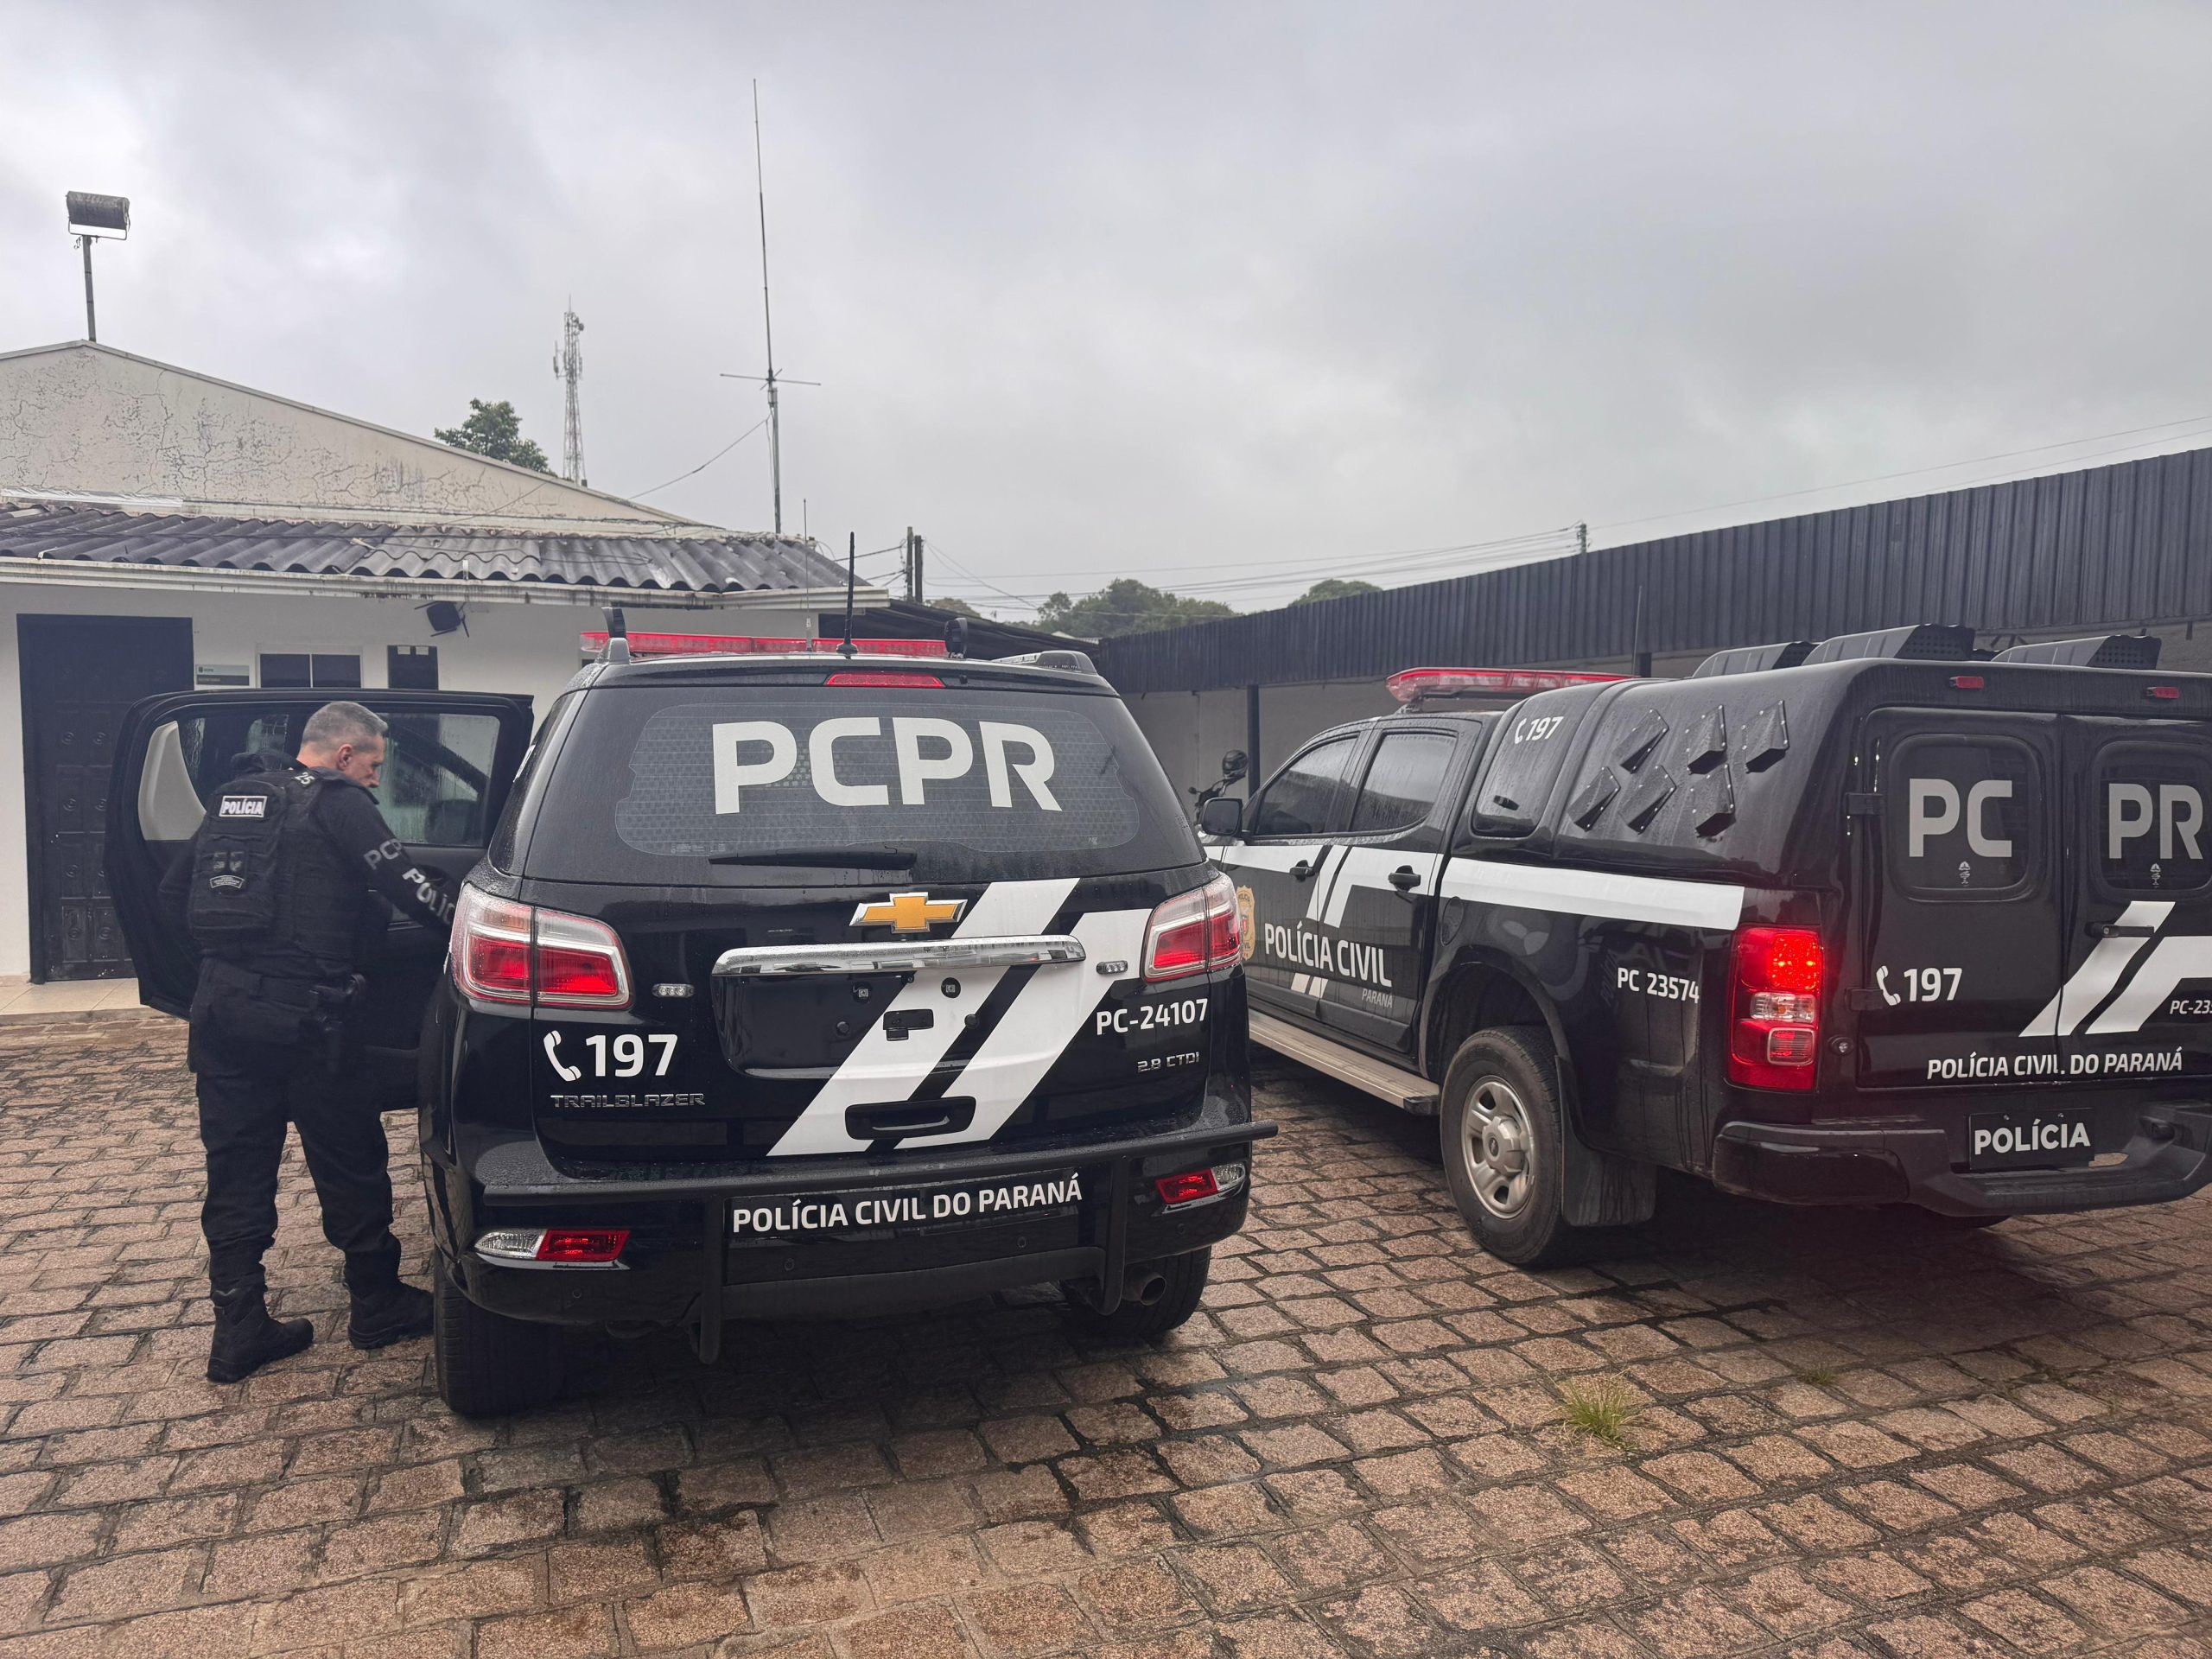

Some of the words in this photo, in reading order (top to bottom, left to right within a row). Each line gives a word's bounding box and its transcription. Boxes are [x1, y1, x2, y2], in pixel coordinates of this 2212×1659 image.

[1526, 716, 1564, 741] 197
[713, 717, 1062, 814] PCPR
[222, 798, 263, 815] POLÍCIA
[1910, 779, 2012, 857] PC
[2109, 784, 2203, 859] PR
[402, 868, 455, 925] POLÍC
[1265, 920, 1334, 972] POLÍCIA
[1337, 939, 1392, 987] CIVIL
[1618, 967, 1639, 992] PC
[1647, 972, 1700, 1003] 23574
[1904, 968, 1962, 1001] 197
[1096, 998, 1208, 1035] PC-24107
[586, 1034, 678, 1077] 197
[1166, 1052, 1199, 1067] CTDI
[1927, 1052, 2009, 1080] POLÍCIA
[2069, 1053, 2100, 1074] DO
[2104, 1046, 2183, 1073] PARANÁ
[550, 1093, 705, 1108] TRAILBLAZER
[1974, 1119, 2091, 1156] POLÍCIA
[733, 1199, 849, 1233] POLÍCIA
[855, 1197, 926, 1224] CIVIL
[933, 1192, 971, 1218] DO
[979, 1173, 1083, 1213] PARANÁ
